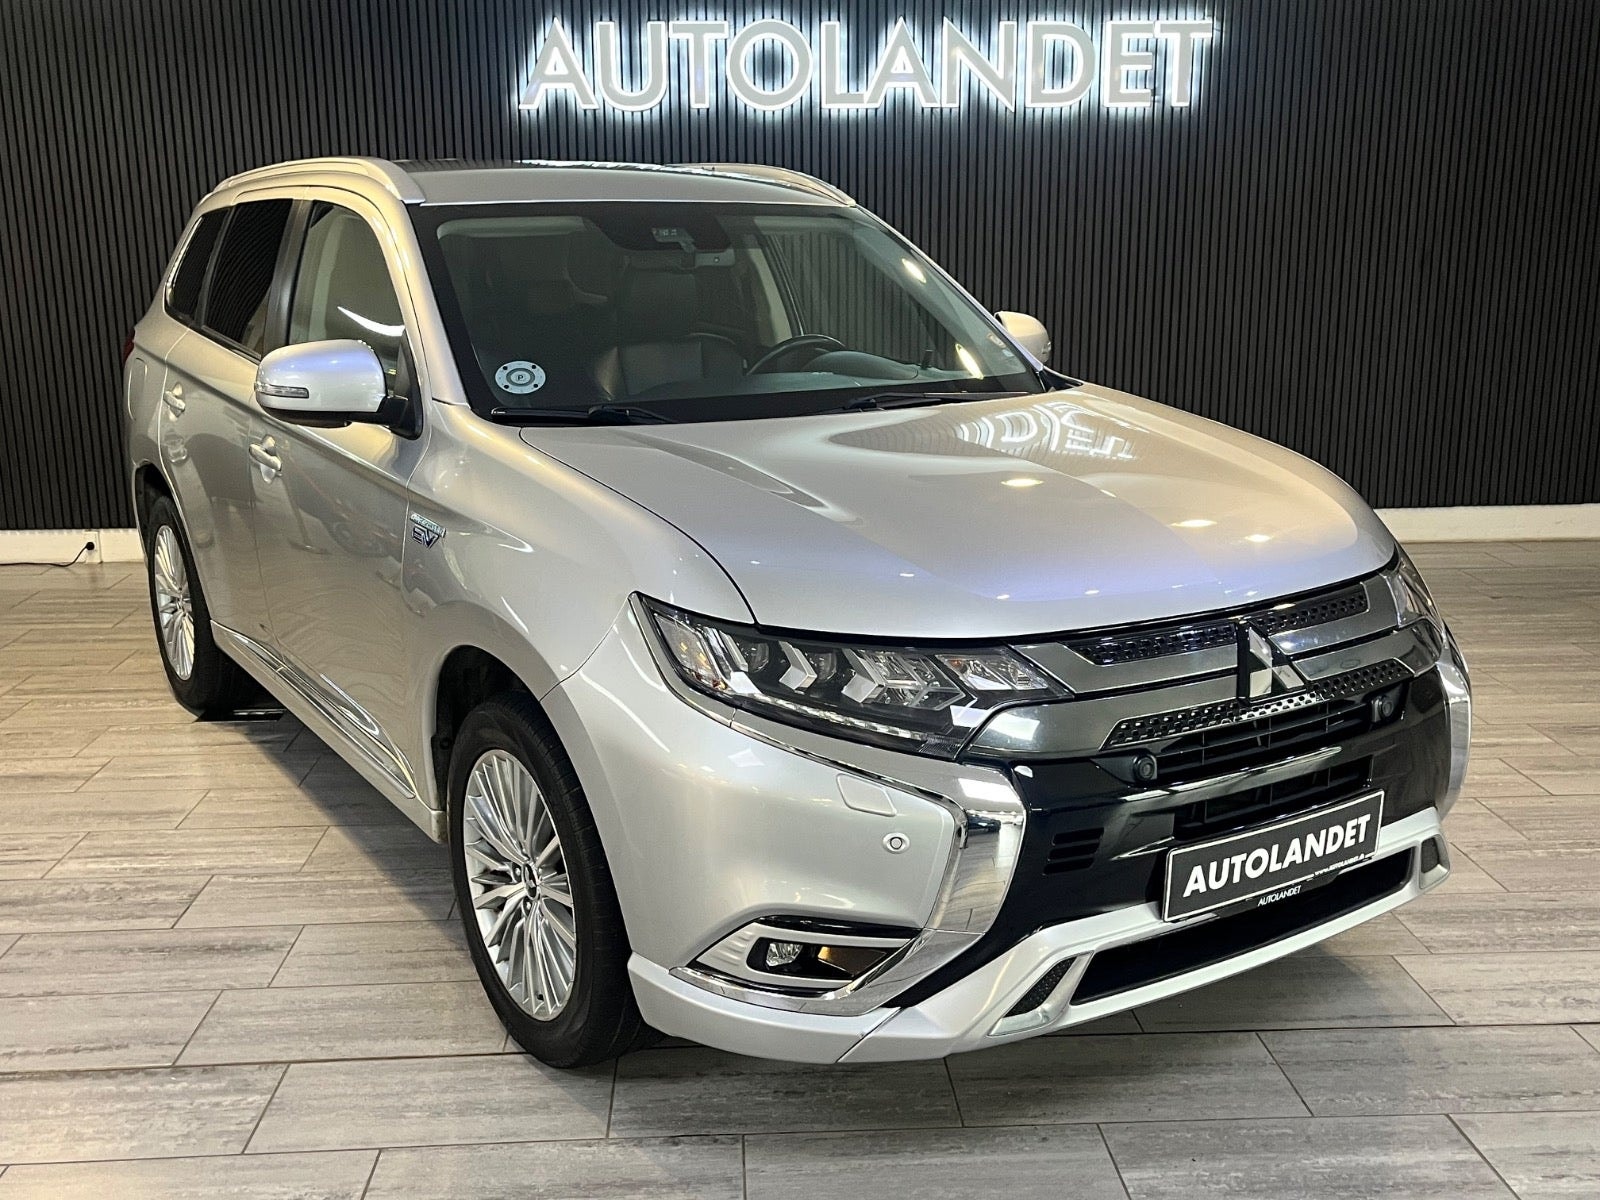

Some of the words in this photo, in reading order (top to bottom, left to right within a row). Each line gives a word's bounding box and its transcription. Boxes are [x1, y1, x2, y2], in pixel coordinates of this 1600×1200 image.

[518, 16, 1213, 112] AUTOLANDET
[1183, 814, 1371, 898] AUTOLANDET
[1257, 884, 1302, 907] AUTOLANDET
